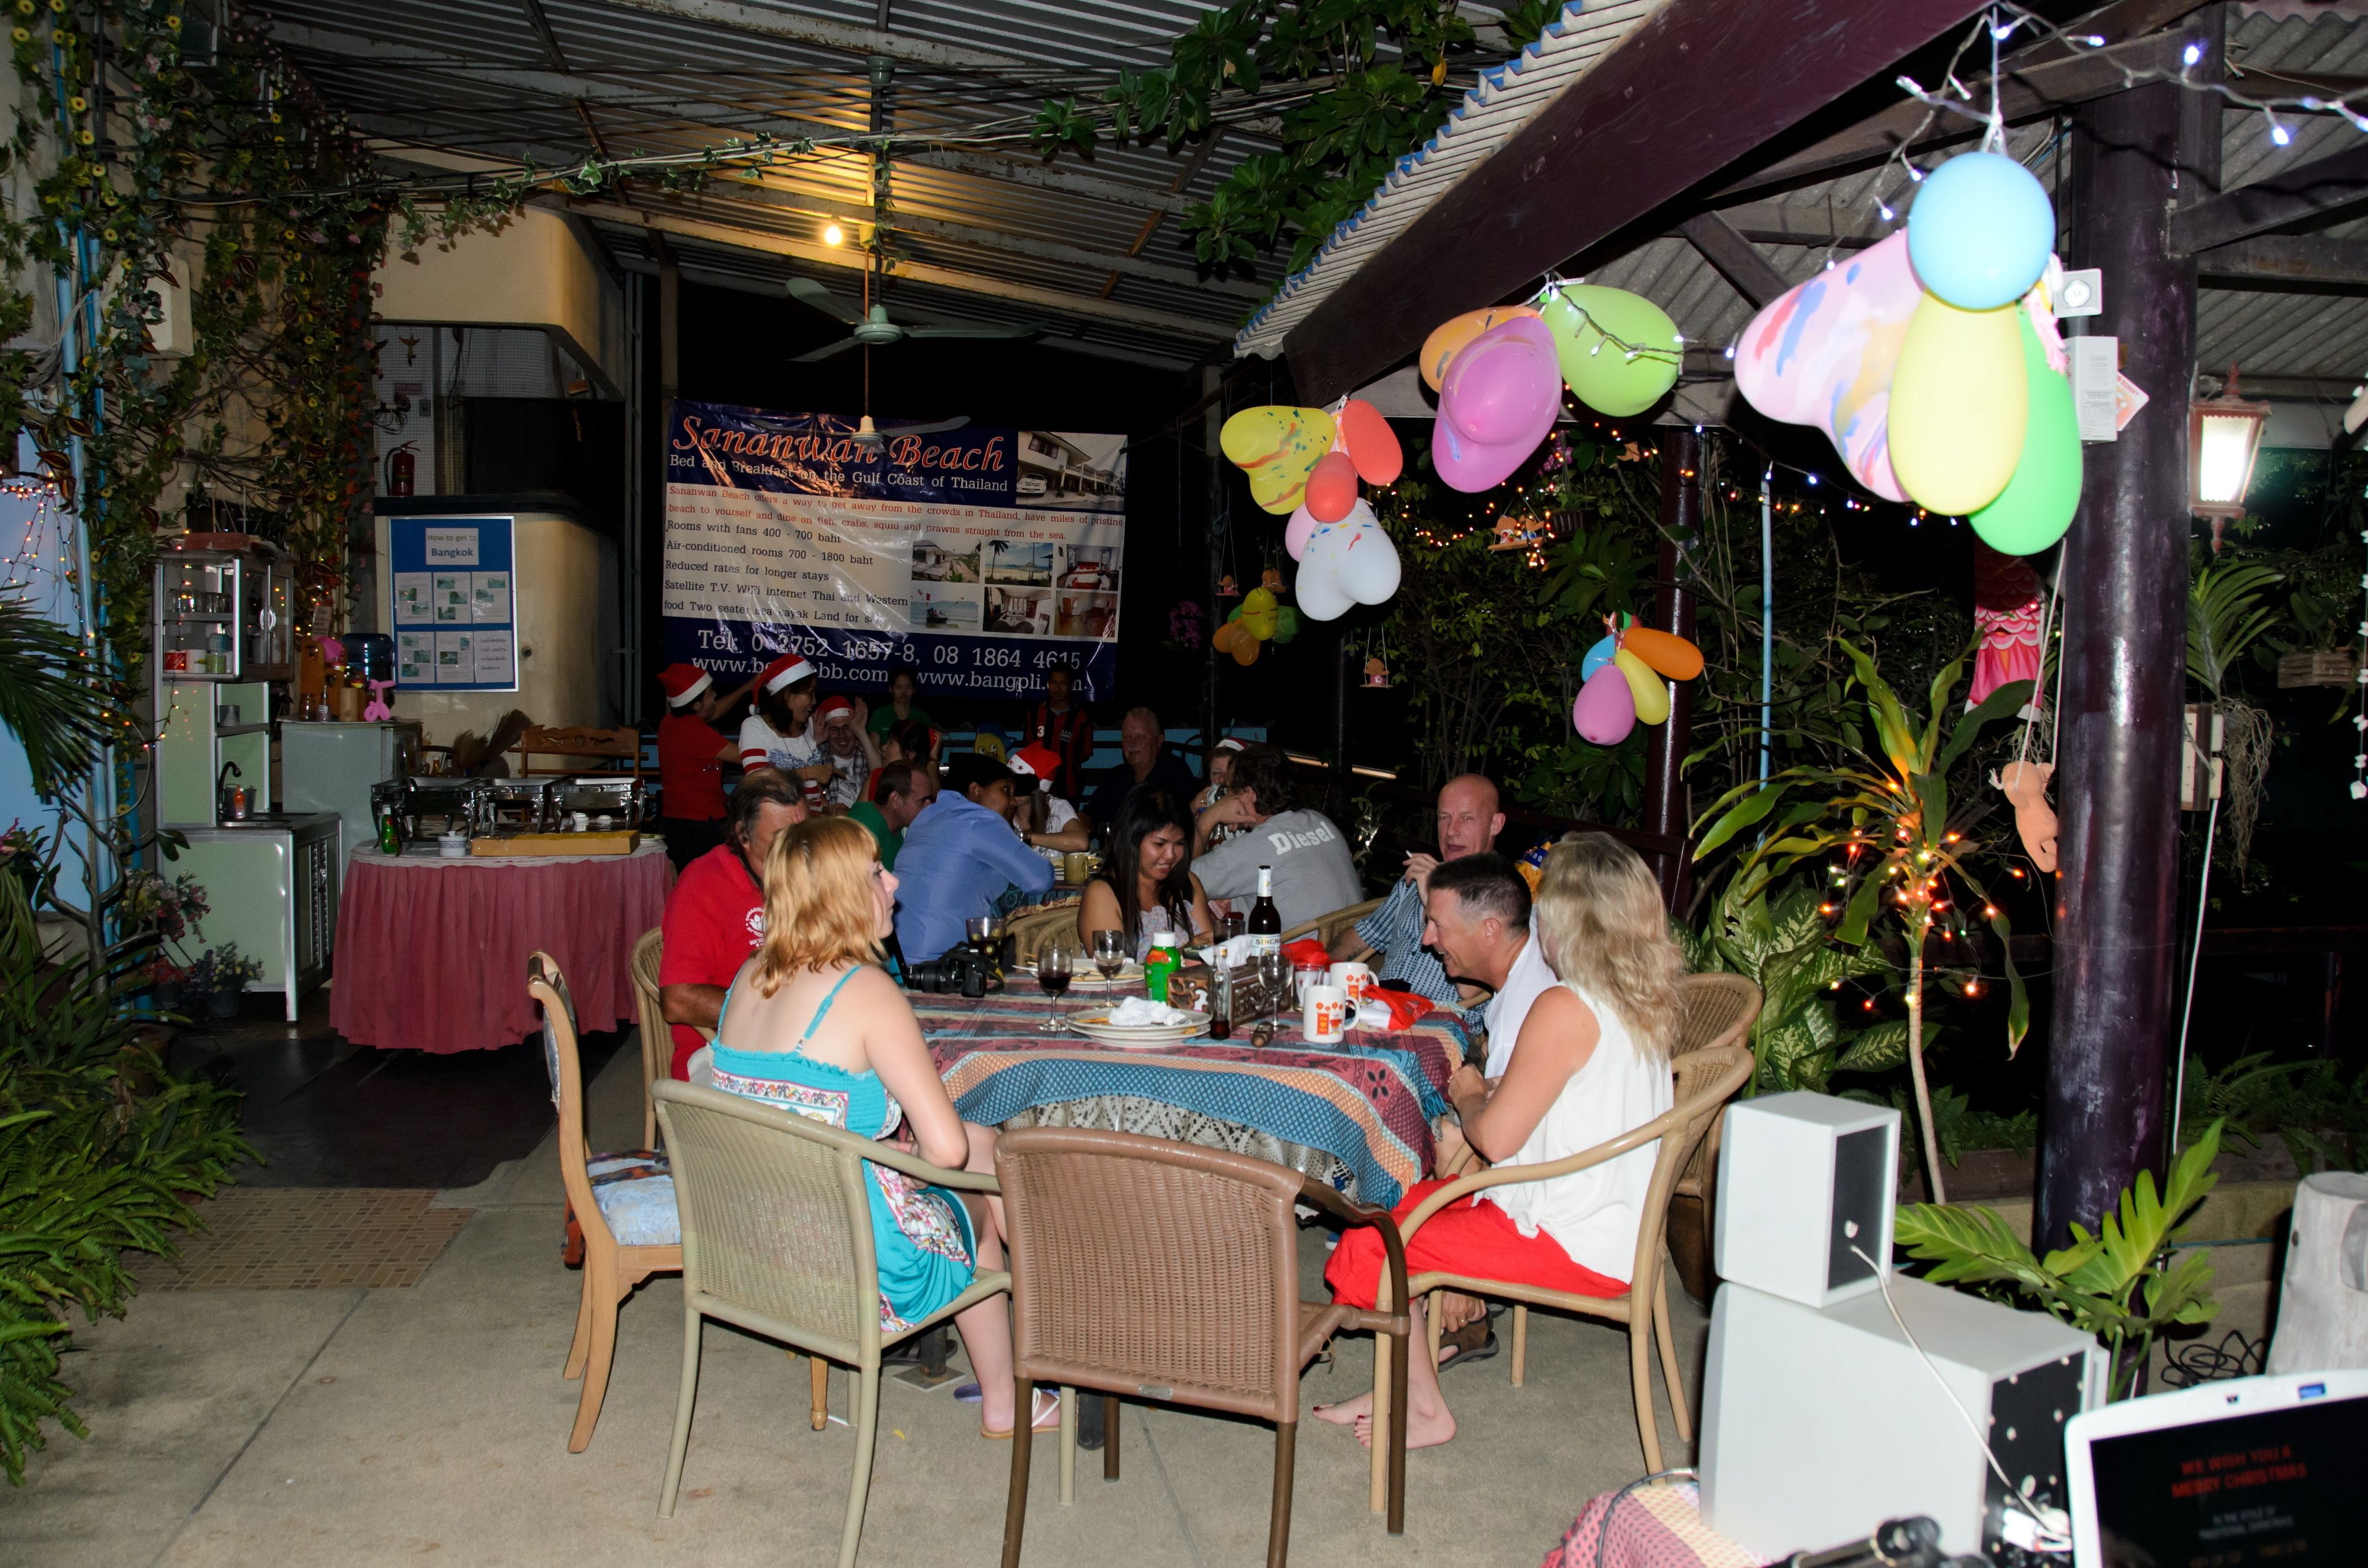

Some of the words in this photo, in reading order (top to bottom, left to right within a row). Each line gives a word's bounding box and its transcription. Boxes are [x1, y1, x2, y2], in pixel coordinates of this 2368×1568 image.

[673, 416, 878, 464] Sananwan
[889, 434, 1004, 471] Beach
[670, 454, 695, 467] Bed
[702, 458, 726, 470] and
[732, 461, 793, 478] Breakfast
[801, 470, 816, 480] on
[824, 467, 845, 482] the
[852, 472, 881, 484] Gulf
[887, 473, 924, 486] Coast
[932, 476, 945, 487] of
[952, 477, 1008, 491] Thailand
[668, 504, 696, 513] beach
[701, 506, 710, 514] to
[715, 509, 752, 517] yourself
[756, 512, 773, 520] and
[777, 513, 797, 522] dine
[874, 521, 899, 531] squid
[904, 523, 921, 532] and
[926, 525, 960, 534] prawns
[964, 527, 999, 537] straight
[1005, 528, 1024, 538] from
[1030, 530, 1044, 538] the
[670, 486, 717, 497] Sananwan
[722, 490, 750, 501] Beach
[754, 494, 778, 504] offers
[793, 498, 813, 508] way
[831, 501, 846, 509] get
[852, 503, 876, 512] away
[881, 504, 902, 512] from
[908, 505, 923, 514] the
[927, 506, 960, 516] crowds
[965, 508, 974, 517] in
[1025, 513, 1045, 522] have
[1079, 515, 1088, 523] of
[1092, 517, 1123, 526] pristine
[668, 520, 701, 531] Rooms
[707, 522, 730, 533] with
[736, 524, 757, 535] fans
[763, 528, 781, 538] 400
[795, 530, 813, 540] 700
[818, 533, 841, 543] baht
[432, 548, 474, 559] Bangkok
[667, 540, 746, 554] Air-conditioned
[752, 546, 783, 558] rooms
[789, 549, 807, 559] 700
[821, 552, 845, 562] 1800
[850, 554, 873, 565] baht
[666, 560, 709, 572] Reduced
[714, 564, 740, 573] rates
[746, 565, 759, 575] for
[765, 566, 797, 579] longer
[802, 572, 829, 581] stays
[665, 580, 705, 591] Satellite
[710, 583, 731, 593] T.V.
[737, 584, 760, 595] WiFi
[767, 586, 807, 599] internet
[812, 591, 835, 601] Thai
[841, 593, 860, 602] and
[866, 594, 908, 606] Western
[664, 600, 684, 610] food
[689, 602, 712, 612] Two
[718, 604, 749, 614] seater
[755, 607, 772, 615] sea
[813, 610, 839, 622] Land
[845, 613, 859, 622] for
[698, 630, 738, 650] Tel:
[776, 634, 828, 657] 2752
[842, 640, 920, 665] 1657-8,
[934, 646, 958, 664] 08
[972, 647, 1021, 667] 1864
[1033, 651, 1080, 670] 4615
[1267, 821, 1336, 856] Diesel
[2181, 1459, 2203, 1476] WE
[2208, 1453, 2247, 1471] WISH
[2250, 1447, 2279, 1463] YOU
[2282, 1444, 2292, 1459] A
[2171, 1476, 2221, 1499] MERRY
[2224, 1461, 2308, 1490] CHRISTMAS
